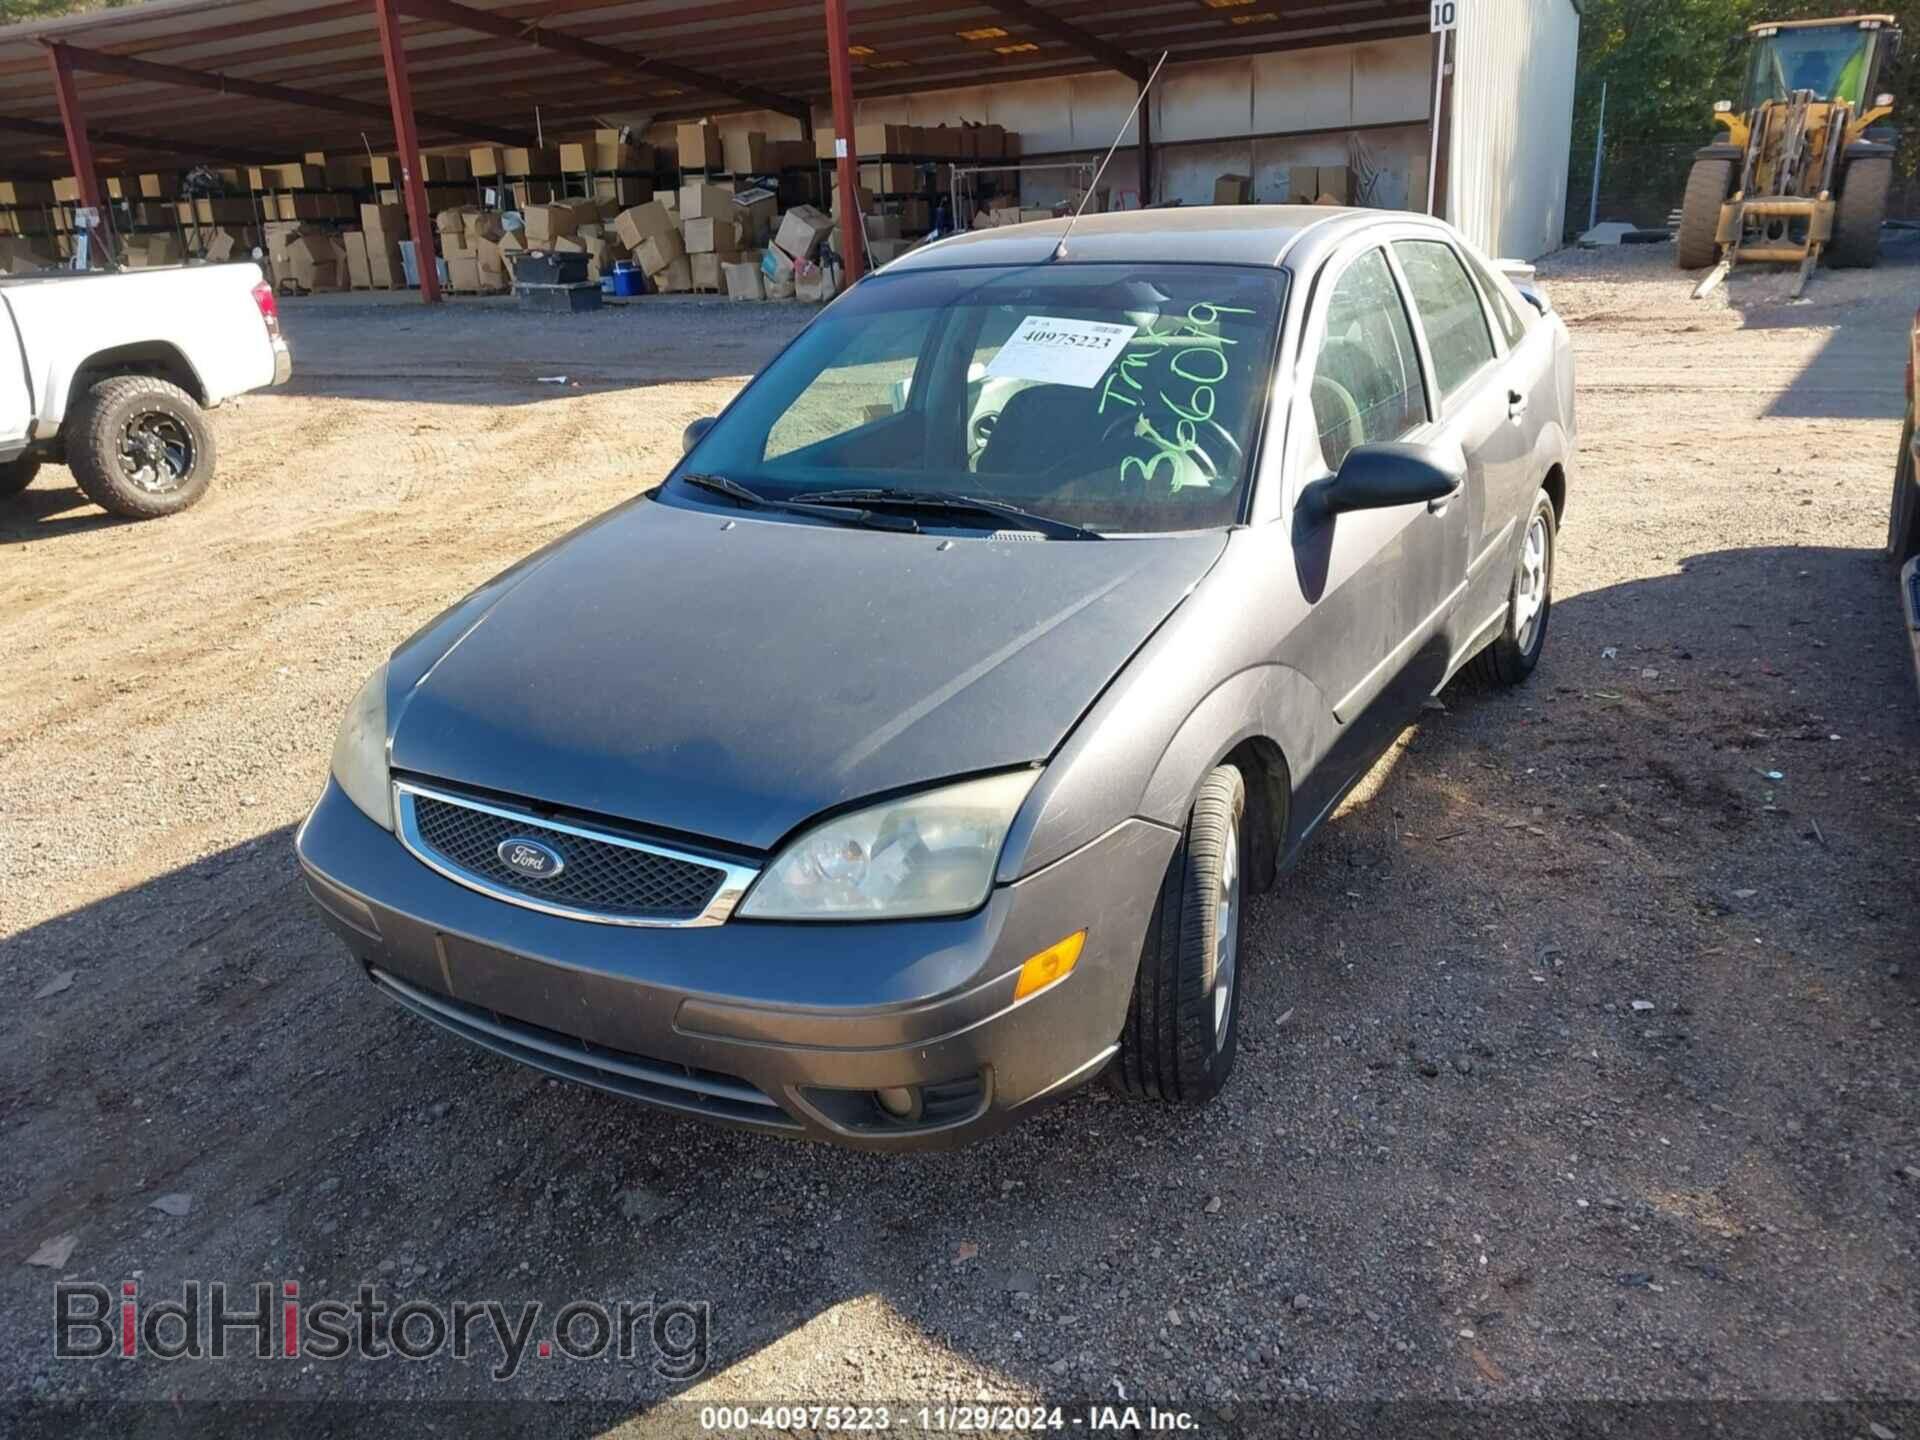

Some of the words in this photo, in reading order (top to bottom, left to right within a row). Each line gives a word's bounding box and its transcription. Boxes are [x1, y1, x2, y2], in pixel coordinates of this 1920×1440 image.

[1434, 2, 1455, 26] 10
[1023, 330, 1112, 349] 40975223
[511, 846, 545, 870] Ford
